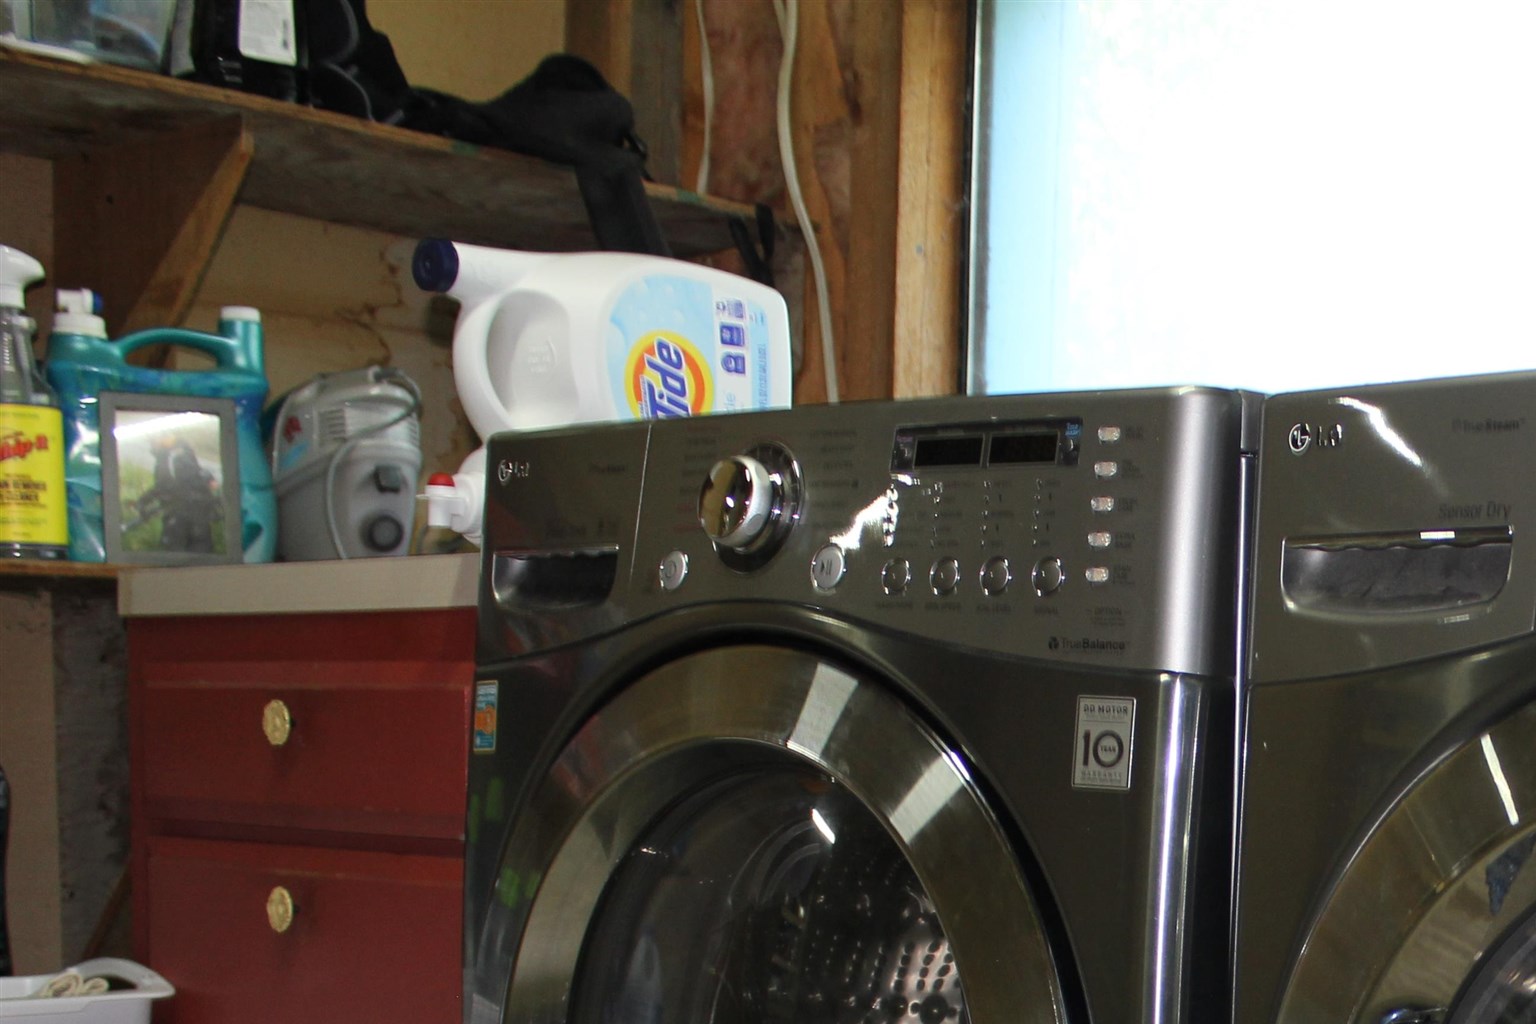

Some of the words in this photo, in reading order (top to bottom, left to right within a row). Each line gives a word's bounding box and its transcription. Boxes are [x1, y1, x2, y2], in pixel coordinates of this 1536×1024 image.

[643, 336, 692, 418] Tide
[1439, 503, 1483, 519] Sensor
[1486, 500, 1512, 522] Dry
[1060, 636, 1126, 650] TrueBalance
[1098, 704, 1129, 716] MOTOR
[1082, 729, 1125, 768] 10
